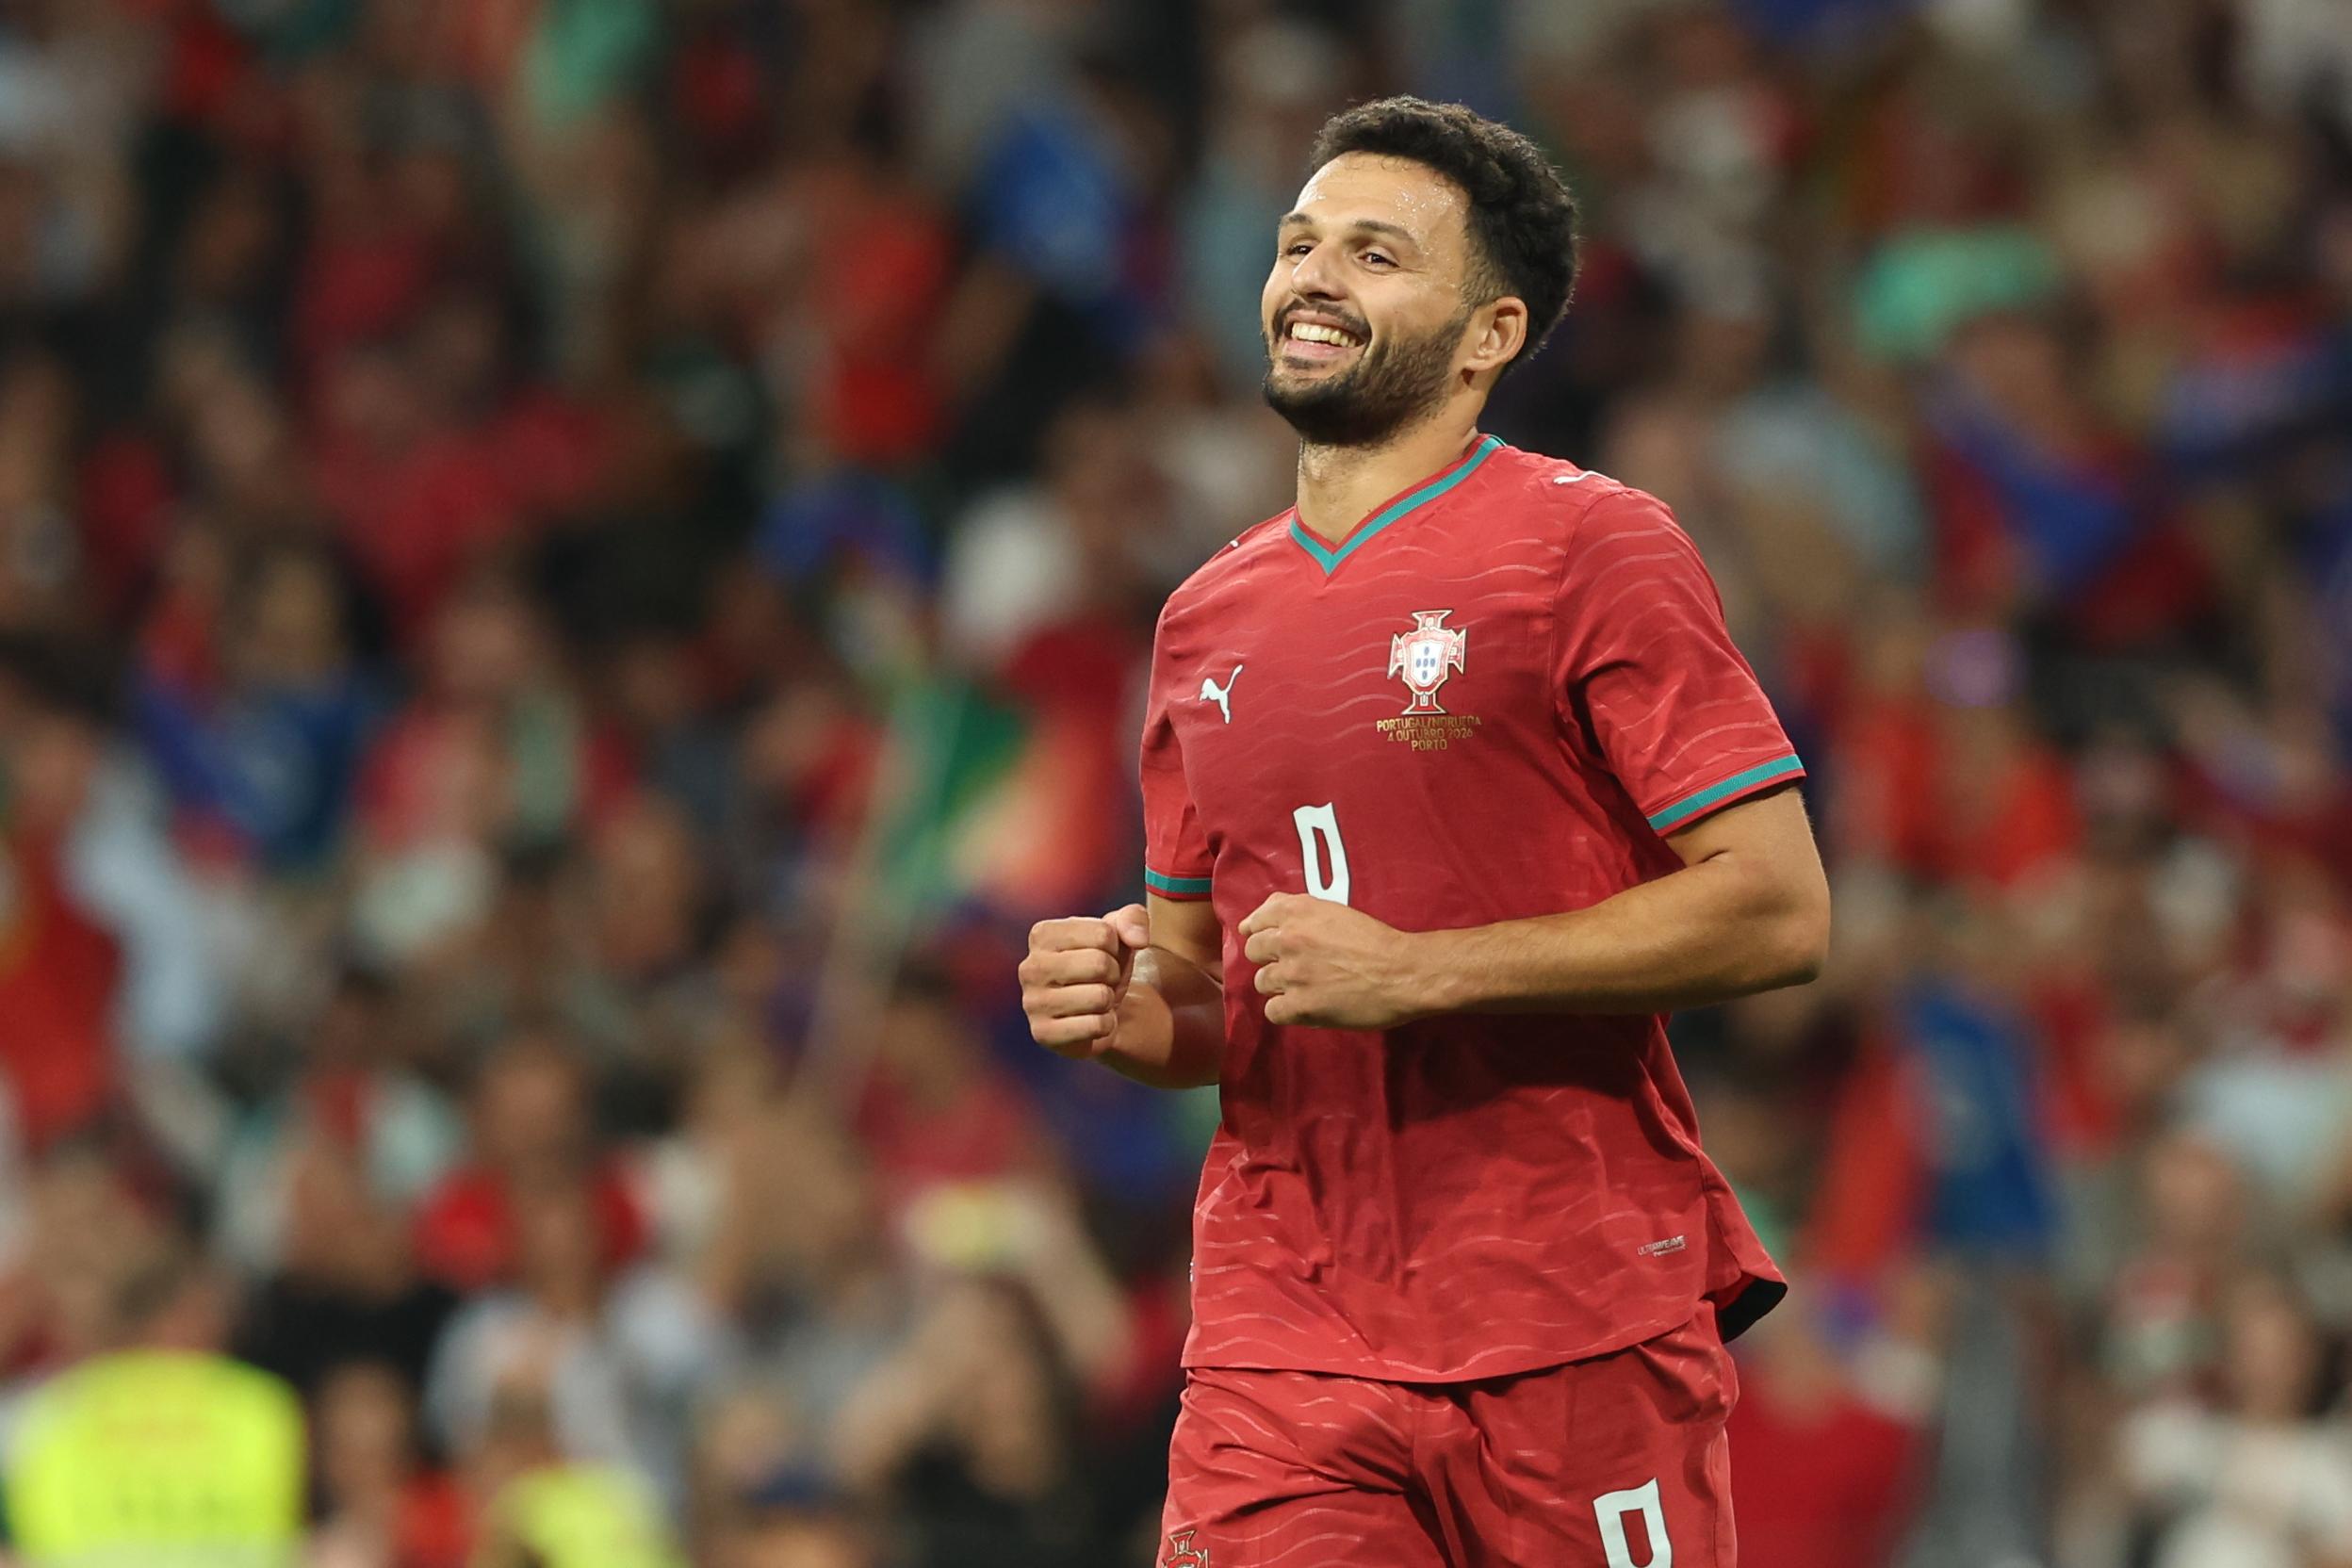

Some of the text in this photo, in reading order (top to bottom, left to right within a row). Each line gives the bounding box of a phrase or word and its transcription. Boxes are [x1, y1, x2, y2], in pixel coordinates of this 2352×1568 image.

[1387, 731, 1395, 742] 4
[1396, 728, 1446, 741] OUTUBRO
[1411, 739, 1448, 751] PORTO
